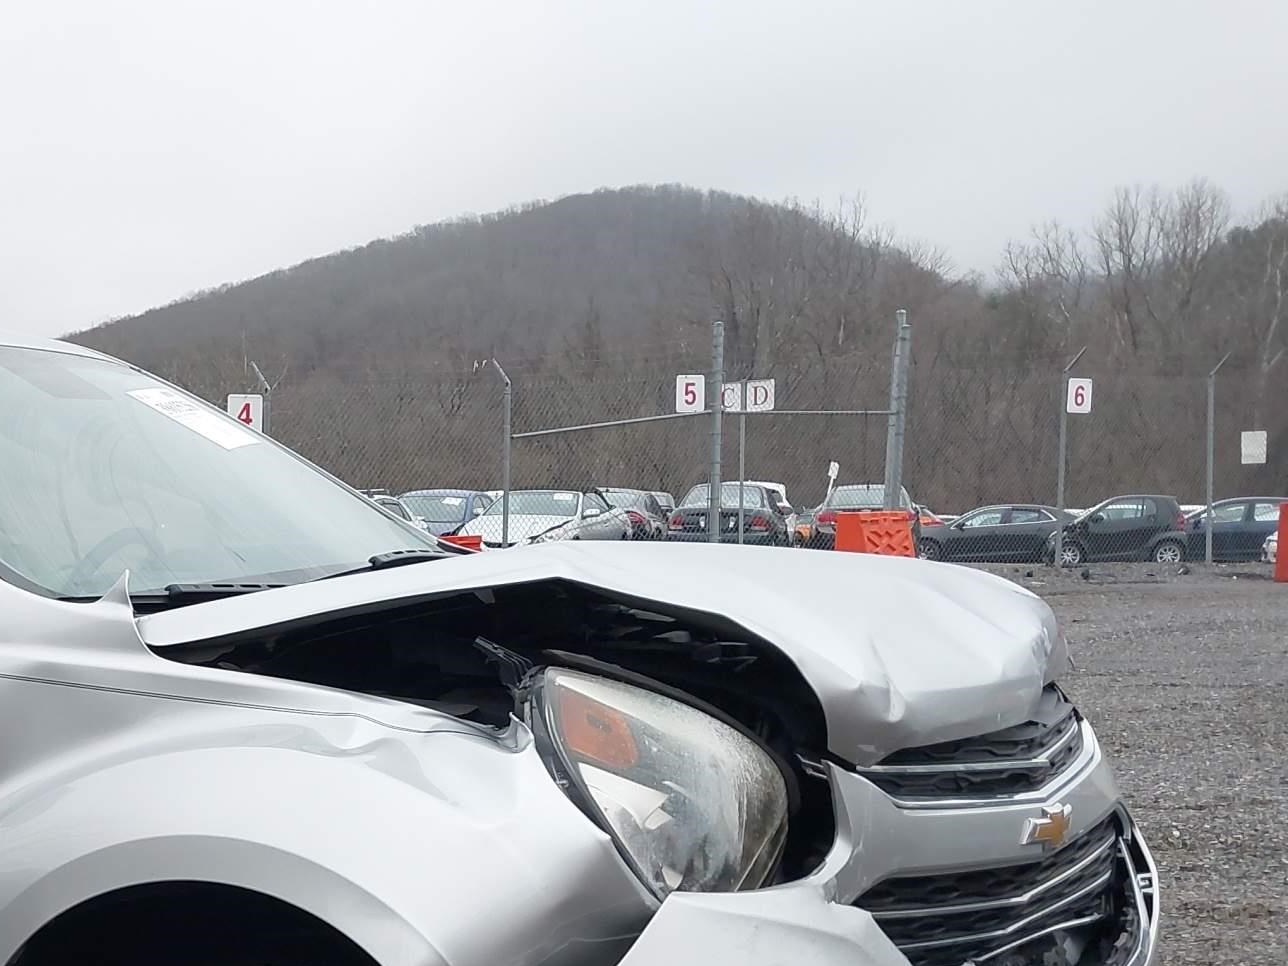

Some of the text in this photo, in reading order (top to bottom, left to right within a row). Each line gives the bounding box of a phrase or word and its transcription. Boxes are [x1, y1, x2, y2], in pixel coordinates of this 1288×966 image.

[684, 382, 697, 406] 5
[720, 387, 736, 409] C
[752, 385, 769, 406] D
[1074, 385, 1085, 407] 6
[237, 402, 253, 426] 4
